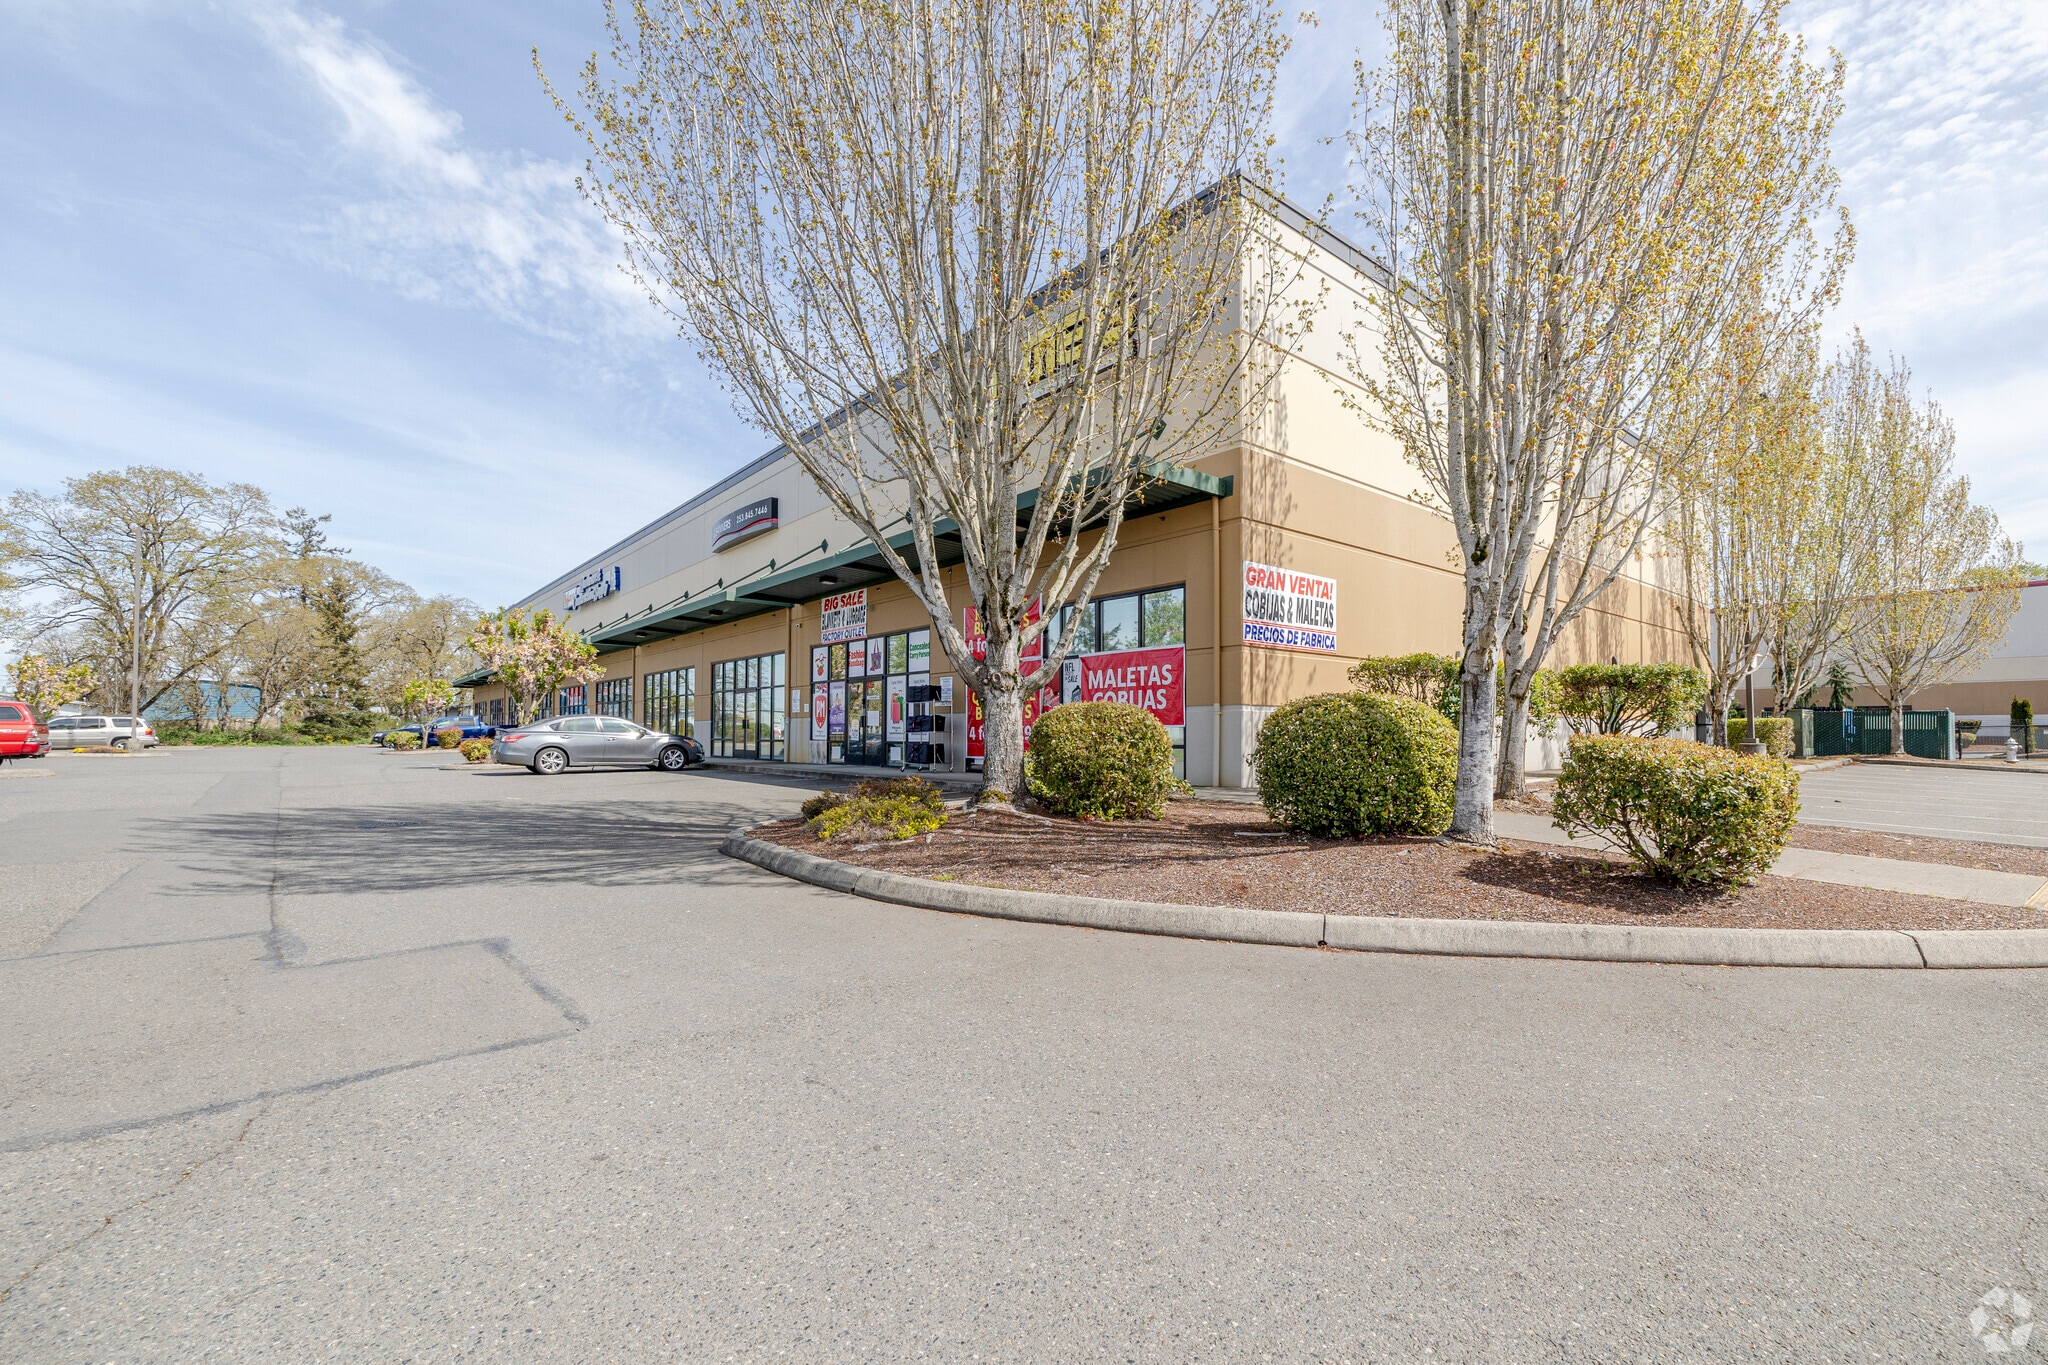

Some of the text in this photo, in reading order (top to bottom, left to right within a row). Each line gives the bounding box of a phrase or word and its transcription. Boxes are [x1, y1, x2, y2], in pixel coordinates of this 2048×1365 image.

[1246, 566, 1333, 600] GRAN VENTA!
[824, 590, 864, 612] BIG SALE
[1245, 590, 1334, 629] COBIJAS & MALETAS
[822, 627, 865, 643] FACTORY OUTLET
[1244, 624, 1335, 649] PRECIOS DE FABRICA
[968, 640, 974, 653] 4
[1065, 662, 1074, 672] NFL
[1068, 675, 1078, 683] SALE
[1088, 664, 1173, 690] MALETAS
[816, 700, 825, 717] PM
[969, 726, 976, 740] 4
